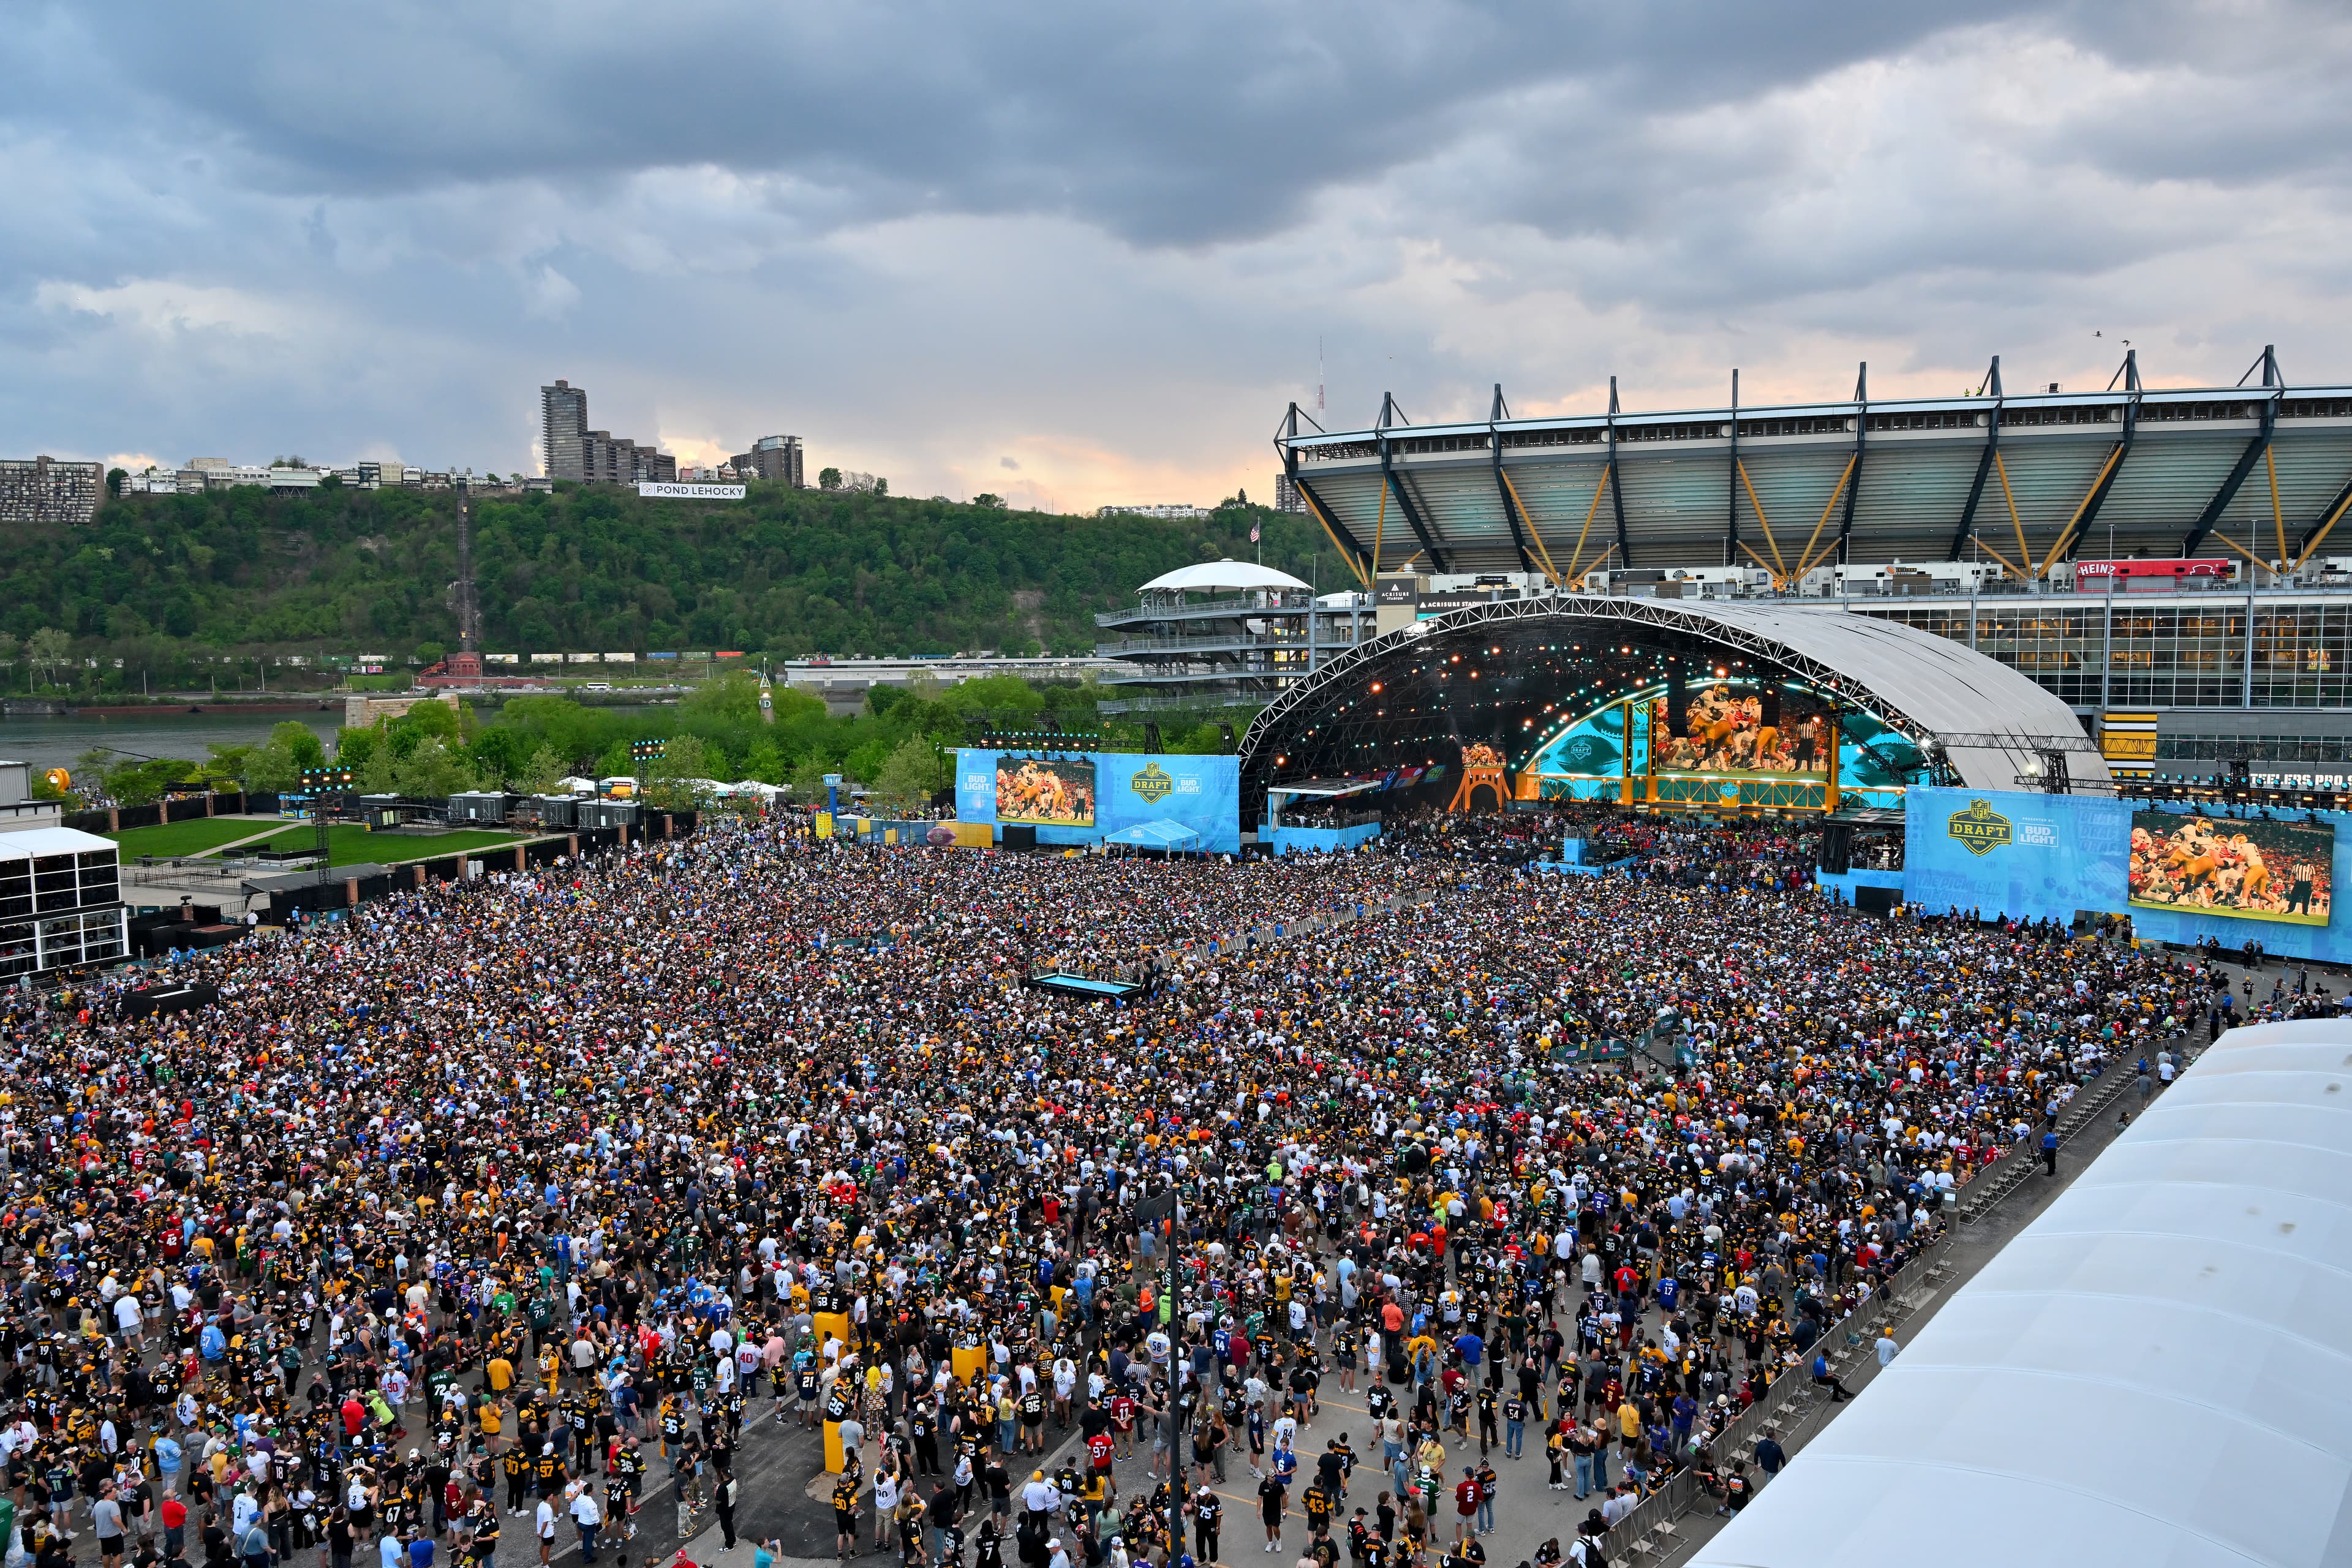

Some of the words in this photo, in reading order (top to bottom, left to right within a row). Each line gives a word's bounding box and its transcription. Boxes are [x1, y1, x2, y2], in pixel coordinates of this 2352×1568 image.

[2080, 564, 2116, 575] HEINZ
[2250, 774, 2310, 785] TEELERS
[2315, 775, 2343, 785] PRO
[1973, 809, 1987, 817] NFL
[1953, 823, 2006, 837] DRAFT
[2026, 826, 2051, 835] BUD
[2020, 834, 2056, 845] LIGHT
[1029, 1254, 1036, 1262] 84
[1245, 1250, 1254, 1259] 43
[50, 1288, 61, 1298] 90
[793, 1296, 801, 1307] 90
[1740, 1295, 1749, 1303] 43
[832, 1301, 837, 1310] 5
[1203, 1302, 1212, 1311] 98
[1421, 1303, 1433, 1315] 88
[1446, 1302, 1458, 1311] 58
[1596, 1300, 1602, 1310] 18
[535, 1308, 544, 1318] 26
[1268, 1306, 1272, 1316] 5
[1467, 1312, 1477, 1322] 97
[40, 1346, 48, 1355] 19
[1053, 1343, 1063, 1354] 97
[1153, 1341, 1161, 1350] 58
[1215, 1341, 1224, 1350] 44
[1341, 1341, 1345, 1350] 8
[99, 1347, 107, 1359] 43
[742, 1353, 753, 1364] 40
[1041, 1361, 1051, 1370] 84
[674, 1374, 680, 1383] 4
[802, 1376, 813, 1387] 21
[1644, 1373, 1649, 1382] 3
[156, 1384, 168, 1393] 90
[388, 1383, 399, 1393] 90
[693, 1378, 705, 1389] 25
[266, 1384, 275, 1396] 88
[435, 1384, 446, 1395] 72
[1371, 1395, 1382, 1405] 36
[1607, 1390, 1612, 1401] 5
[731, 1401, 741, 1412] 43
[829, 1397, 843, 1415] 26
[1027, 1401, 1039, 1412] 95
[1482, 1399, 1487, 1409] 4
[178, 1405, 186, 1416] 92
[1120, 1408, 1128, 1420] 11
[1509, 1409, 1519, 1419] 54
[575, 1418, 584, 1428] 58
[665, 1418, 677, 1433] 36
[915, 1425, 924, 1436] 50
[1284, 1428, 1292, 1438] 84
[1093, 1447, 1106, 1458] 97
[506, 1459, 518, 1474] 90
[540, 1465, 552, 1477] 97
[1278, 1460, 1284, 1471] 6
[276, 1467, 283, 1478] 18
[52, 1480, 62, 1490] 11
[1062, 1480, 1072, 1490] 90
[611, 1490, 620, 1501] 24
[1467, 1491, 1473, 1502] 2
[835, 1498, 846, 1510] 90
[1310, 1498, 1324, 1513] 43
[387, 1506, 400, 1521] 67
[1199, 1506, 1211, 1519] 75
[945, 1537, 955, 1549] 98
[986, 1547, 992, 1559] 7
[1370, 1551, 1376, 1564] 4
